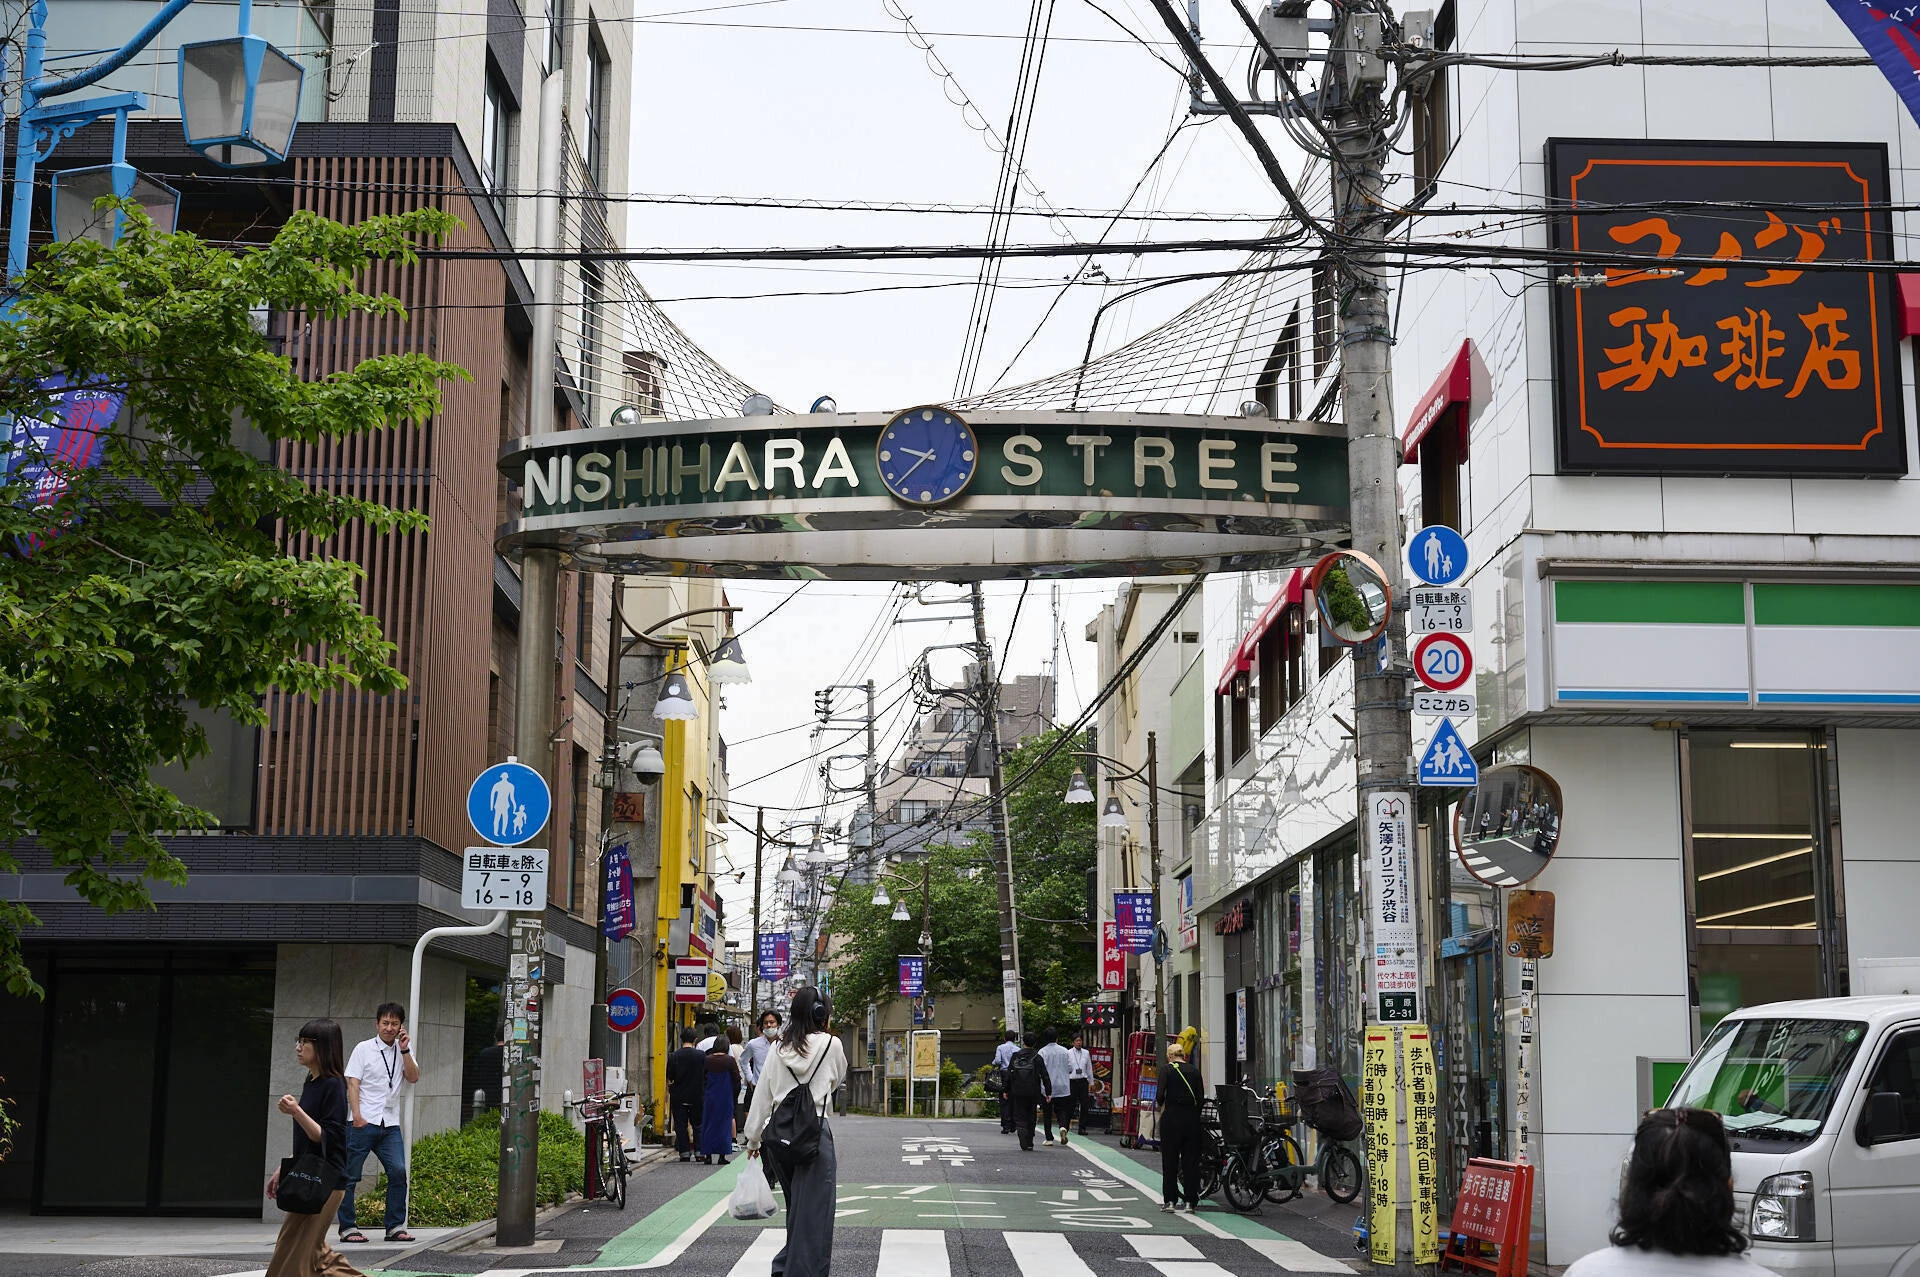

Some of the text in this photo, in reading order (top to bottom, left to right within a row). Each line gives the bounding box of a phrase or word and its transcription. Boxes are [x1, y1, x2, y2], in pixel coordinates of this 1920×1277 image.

[1597, 301, 1862, 399] 珈琲店
[524, 437, 860, 509] NISHIHARA
[1415, 592, 1467, 605] 自転車を除く
[1420, 617, 1463, 630] 16-18
[1427, 648, 1460, 675] 20
[1419, 698, 1470, 712] ここから
[469, 854, 544, 870] 自転車を除く
[1379, 821, 1397, 923] 矢澤クリニック渋谷
[475, 889, 533, 906] 16-18
[1377, 971, 1416, 980] 代々木上原駅
[1377, 981, 1416, 989] 南口徒歩10秒
[609, 1005, 638, 1017] 消防水利
[1389, 1009, 1412, 1018] 2-31
[1463, 1174, 1511, 1203] 歩行者用道路
